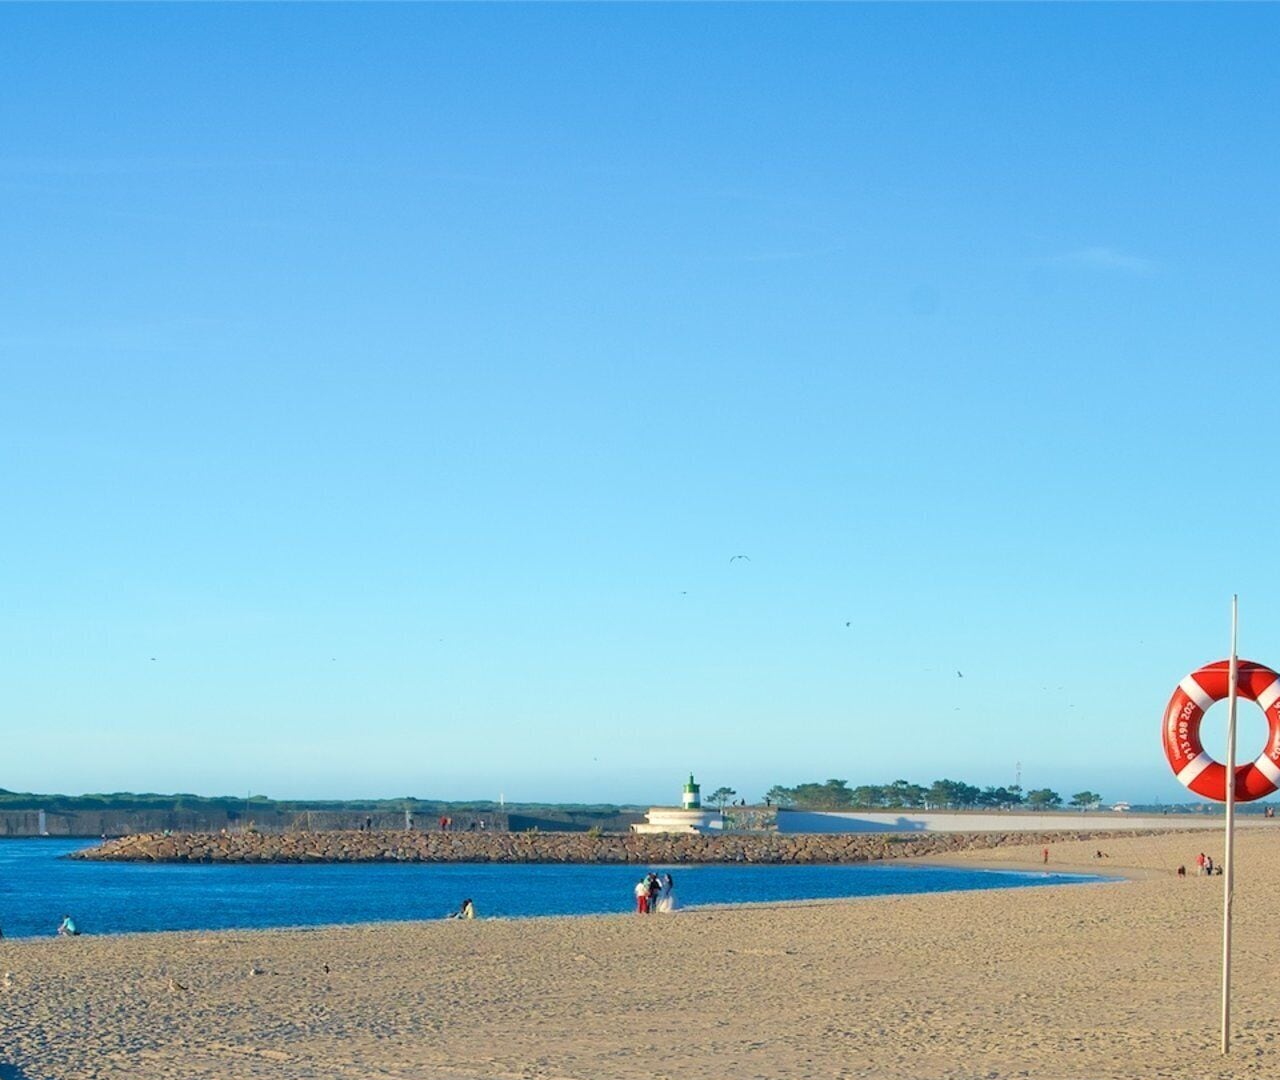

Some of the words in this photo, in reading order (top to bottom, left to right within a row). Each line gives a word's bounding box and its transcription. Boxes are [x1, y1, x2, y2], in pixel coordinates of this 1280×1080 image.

[1181, 701, 1196, 720] 202
[1179, 721, 1188, 740] 498
[1181, 741, 1196, 760] 913
